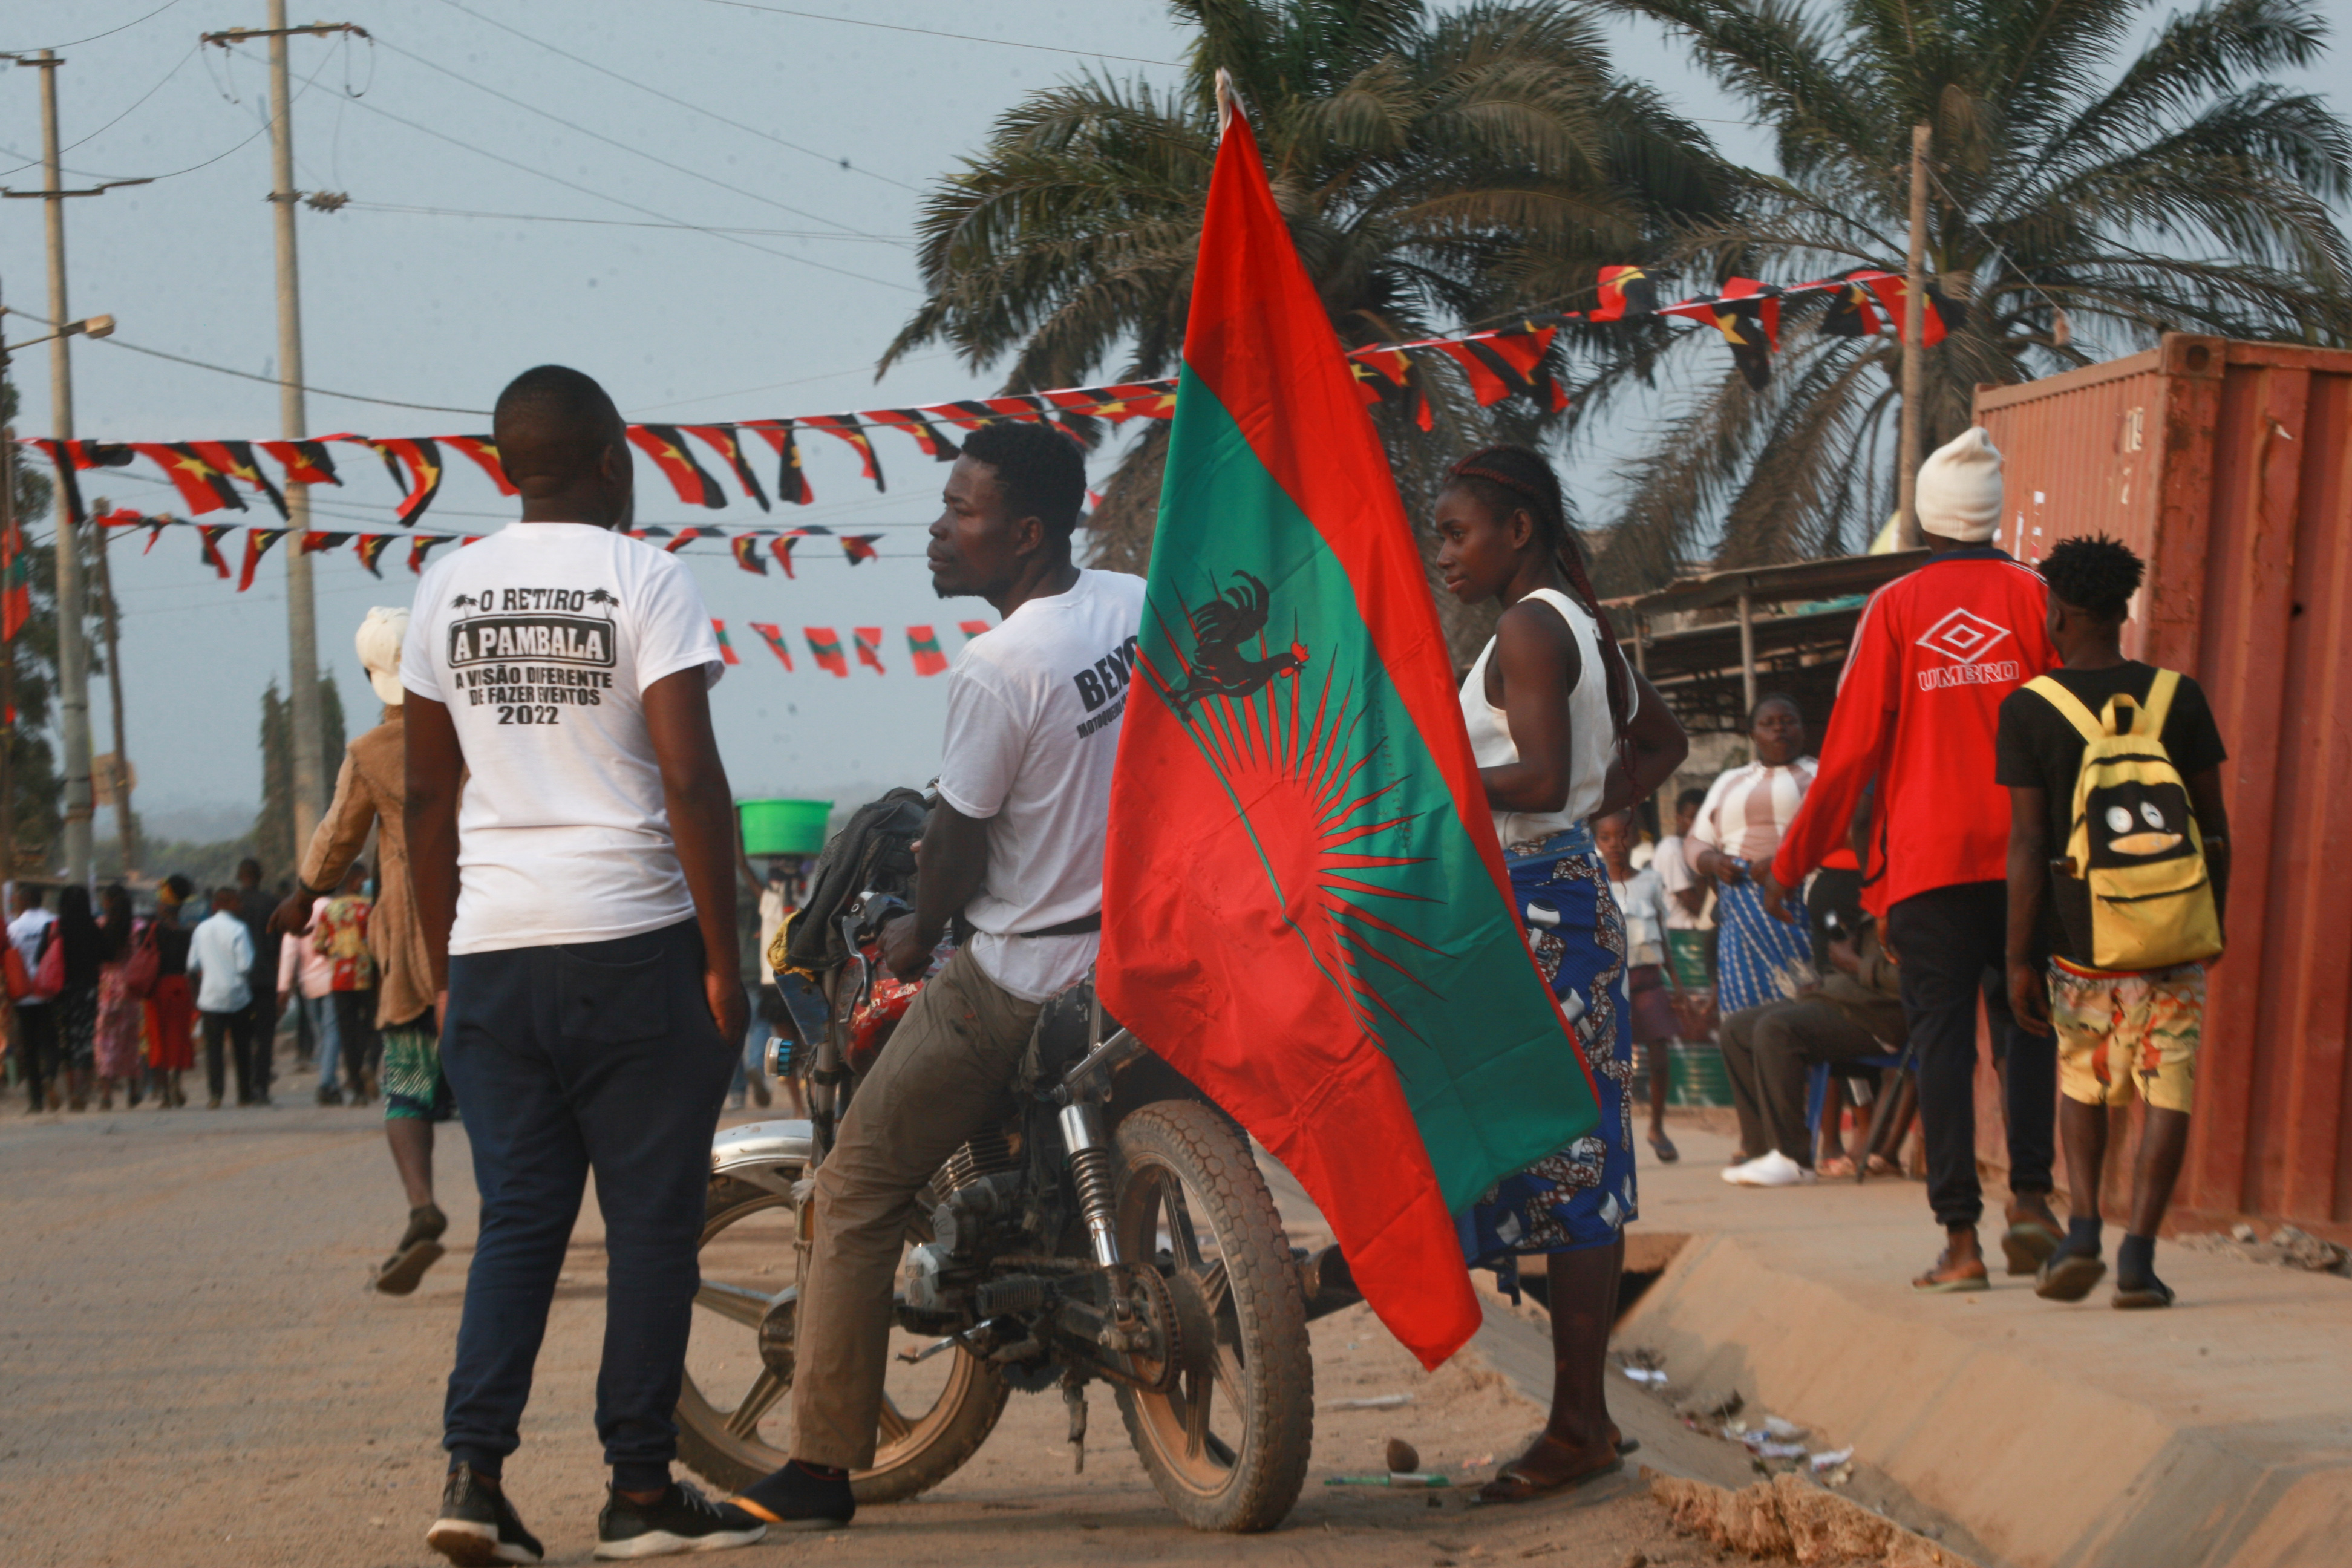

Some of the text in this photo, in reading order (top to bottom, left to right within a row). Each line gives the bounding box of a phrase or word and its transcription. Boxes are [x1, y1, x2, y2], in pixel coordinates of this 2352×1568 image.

[480, 588, 585, 612] O RETIRO
[478, 626, 605, 660] PAMBALA
[456, 665, 613, 689] A VISÃO DIFERENTE
[1917, 661, 2019, 691] UMBRO
[469, 687, 601, 706] DE FAZER EVENTOS
[498, 705, 560, 725] 2022
